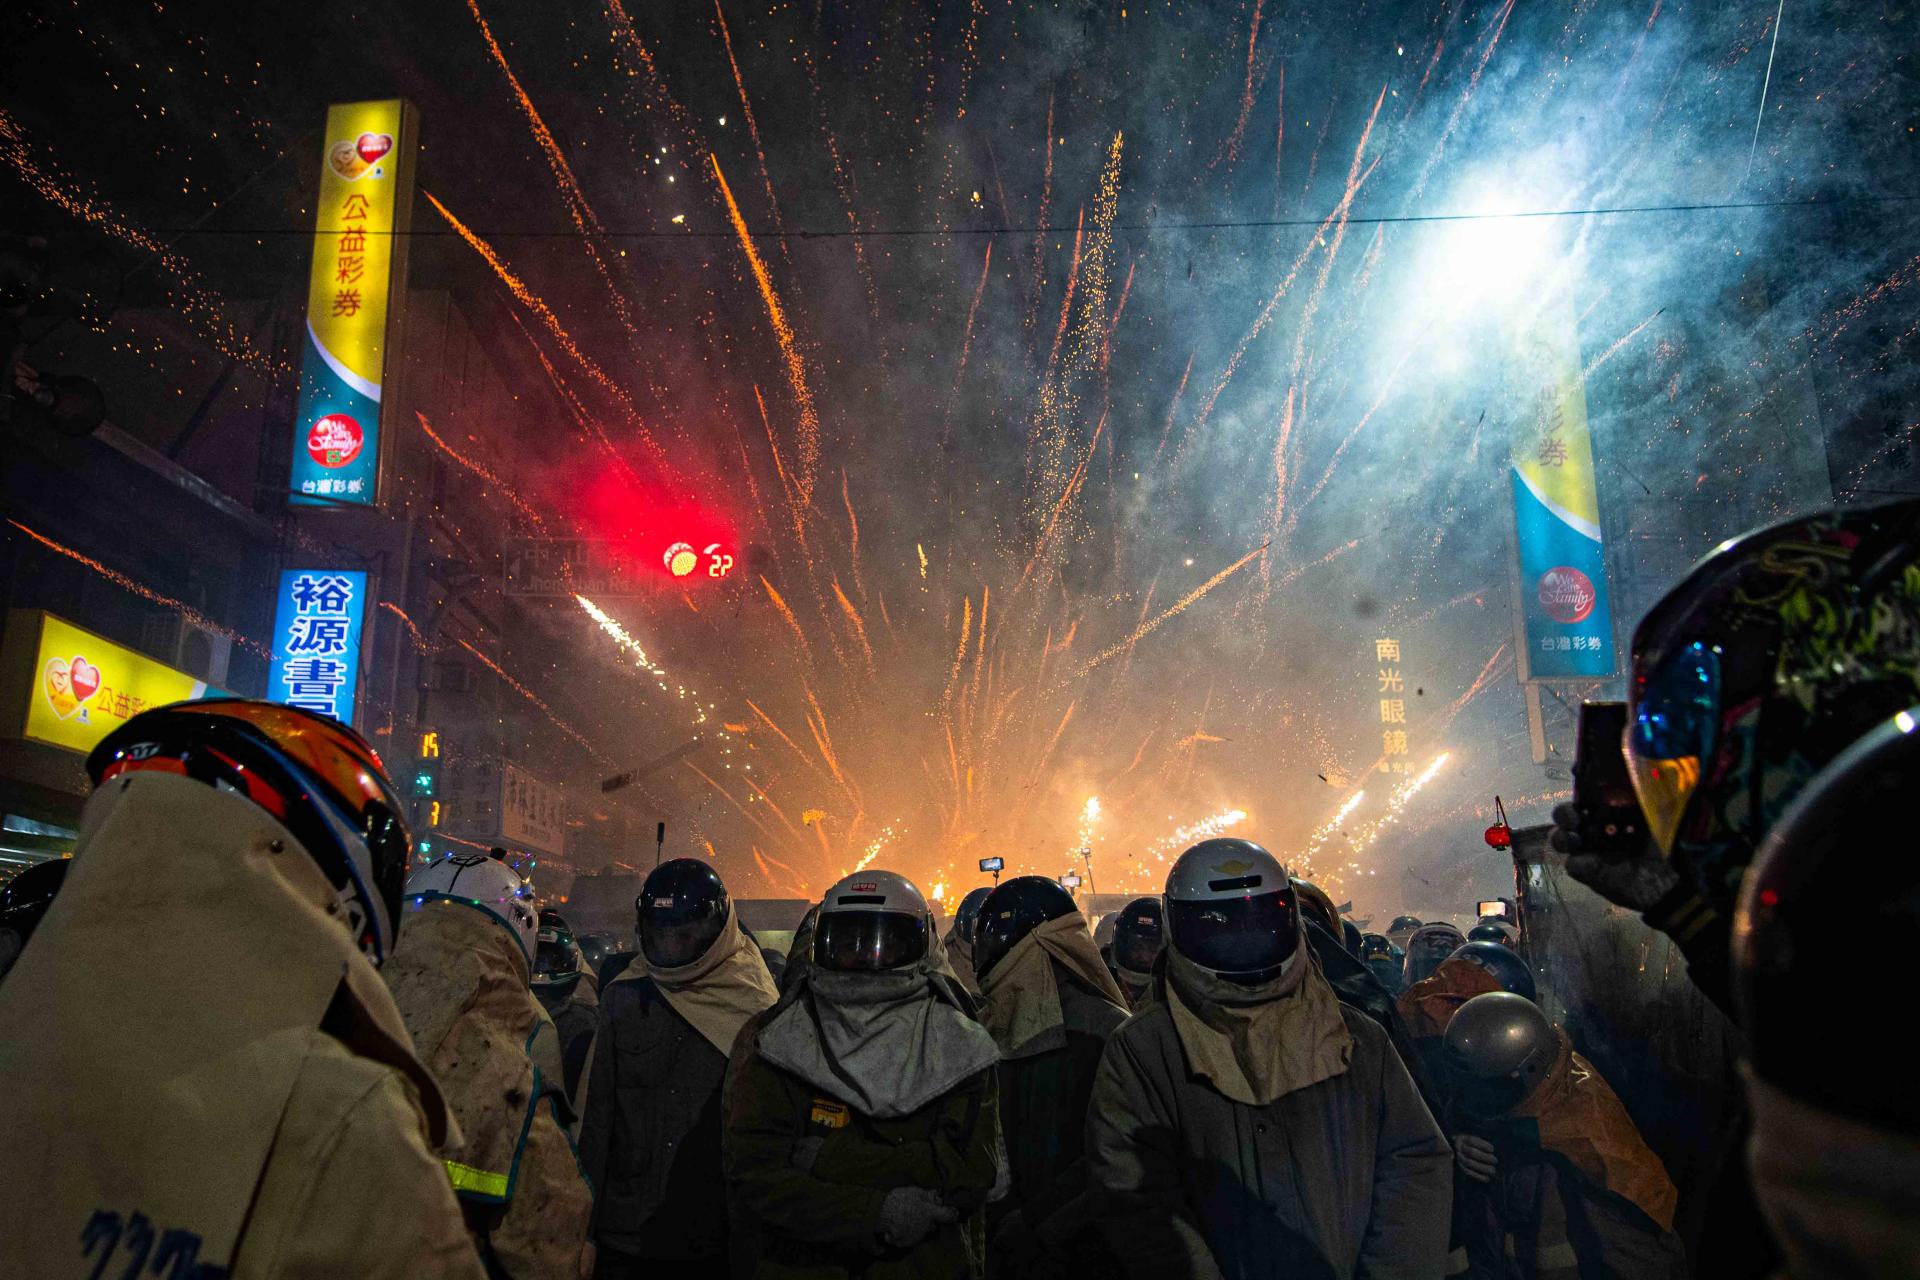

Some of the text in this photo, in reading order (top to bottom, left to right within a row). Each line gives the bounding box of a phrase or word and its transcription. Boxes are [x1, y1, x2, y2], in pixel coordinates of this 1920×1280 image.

[332, 193, 370, 318] 公益彩券
[1541, 636, 1601, 651] 台灣彩券
[97, 686, 160, 720] 公益彩
[1375, 638, 1409, 755] 南光眼鏡
